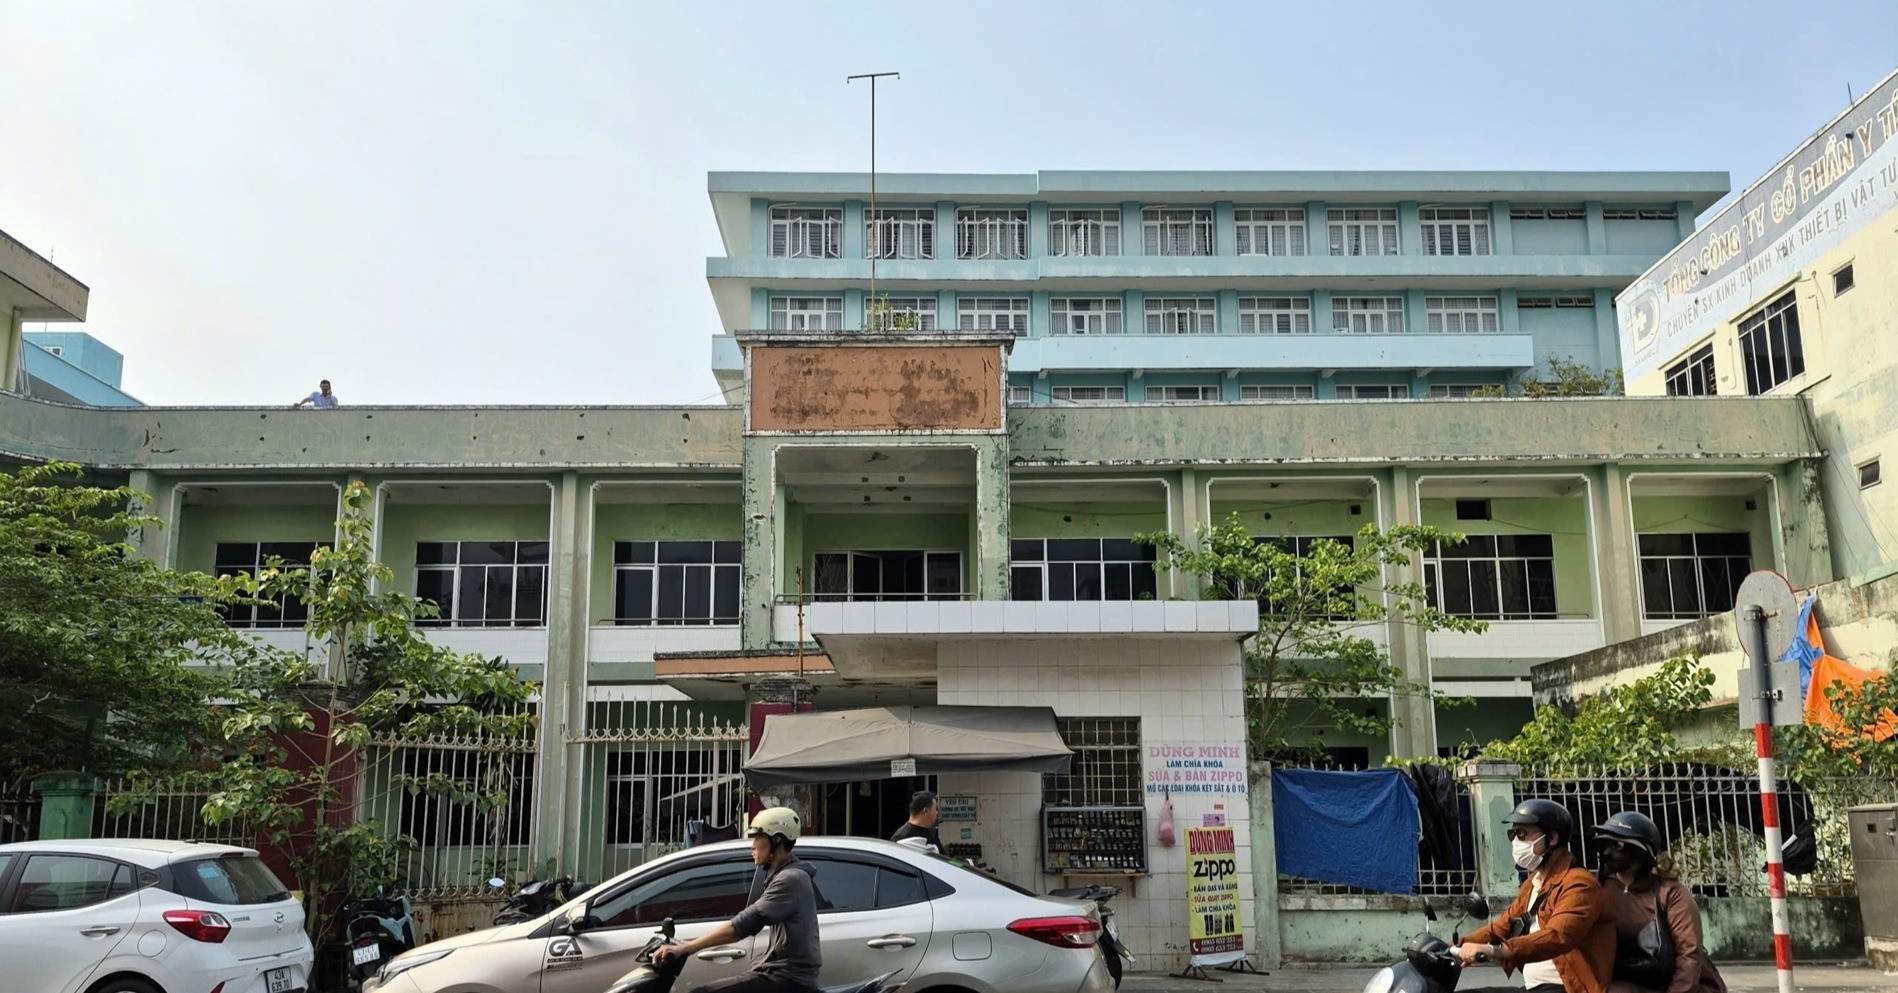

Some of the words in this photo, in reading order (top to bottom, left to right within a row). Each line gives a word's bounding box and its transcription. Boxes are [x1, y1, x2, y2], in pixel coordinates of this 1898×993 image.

[1663, 255, 1699, 303] TỔNG
[1700, 224, 1741, 276] CÔNG
[1743, 202, 1764, 245] TY
[1771, 164, 1797, 224] CỔ
[1800, 133, 1855, 204] PHẦN
[1856, 117, 1873, 159] Y
[1667, 303, 1699, 338] CHUYÊN
[1703, 292, 1714, 314] SX
[1718, 278, 1737, 305] KINH
[1740, 252, 1772, 288] DOANH
[1775, 235, 1795, 261] XNK
[1798, 207, 1830, 246] THIẾT
[1835, 198, 1848, 222] BỊ
[1851, 177, 1875, 209] VẬT
[1199, 746, 1240, 758] MINH
[1173, 770, 1181, 781] &
[1210, 770, 1243, 782] ZIPPO
[1213, 829, 1236, 854] MINH
[275, 969, 285, 980] 43A
